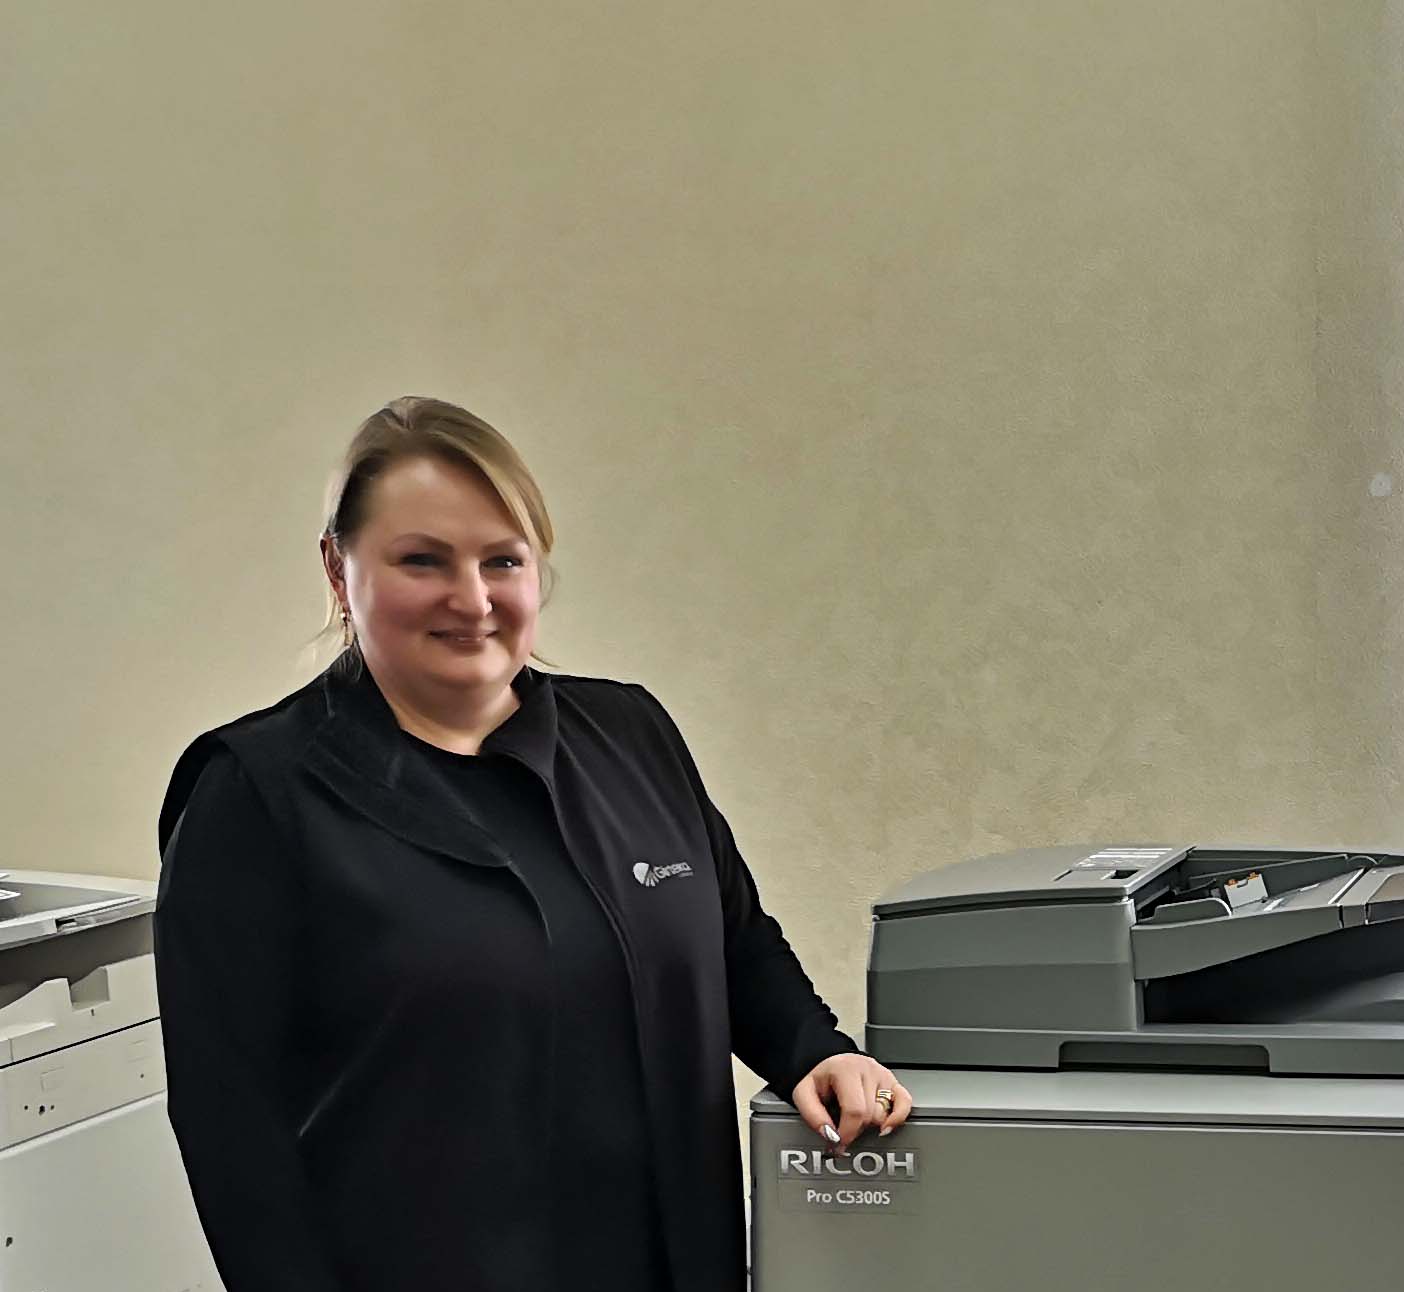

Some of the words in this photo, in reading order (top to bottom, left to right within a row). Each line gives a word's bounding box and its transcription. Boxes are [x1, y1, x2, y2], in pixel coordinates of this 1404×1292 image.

[780, 1150, 915, 1176] RICOH
[807, 1190, 832, 1203] Pro
[836, 1191, 890, 1205] C5300S
